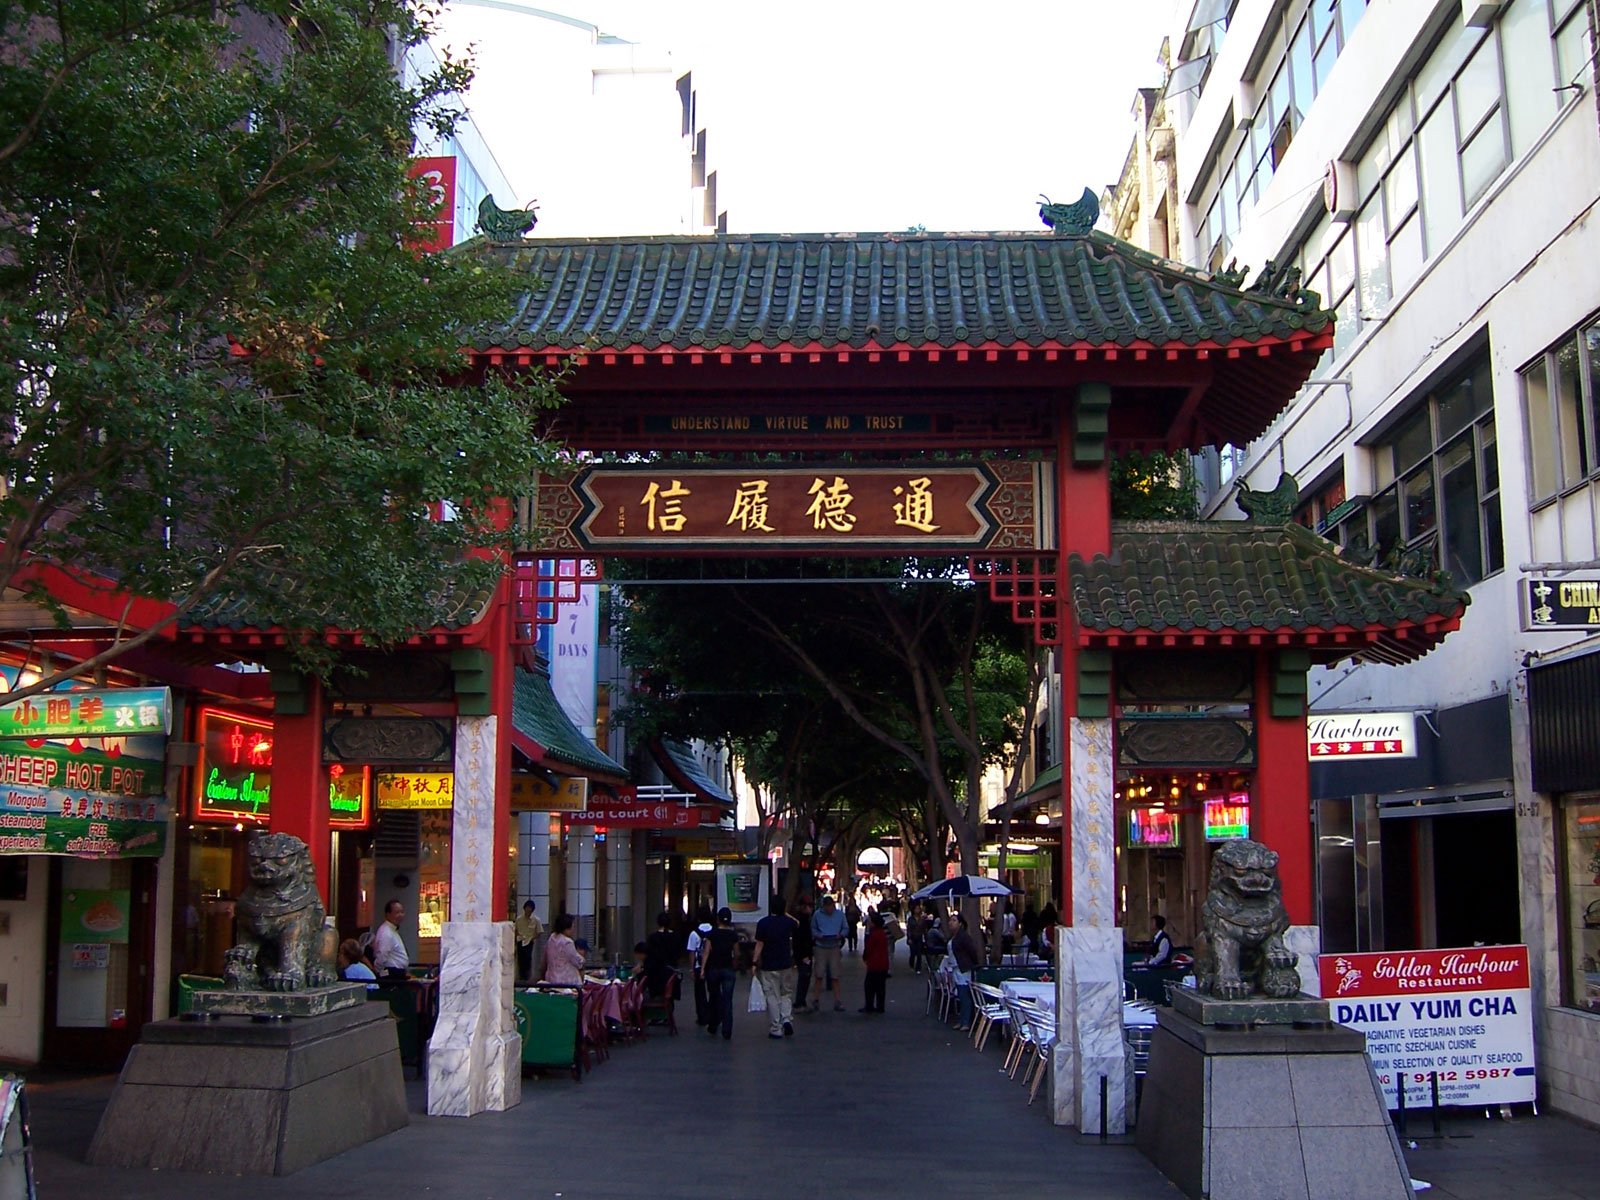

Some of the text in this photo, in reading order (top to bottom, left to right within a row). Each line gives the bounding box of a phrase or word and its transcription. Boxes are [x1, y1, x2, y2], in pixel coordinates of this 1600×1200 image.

[671, 415, 905, 430] UNDERSTAND VIRTUE AND TRUST
[569, 613, 579, 635] 7
[558, 644, 588, 657] DAYS
[13, 696, 104, 727] 小肥羊
[1307, 718, 1401, 740] Harbour
[66, 761, 105, 791] HOT
[111, 766, 145, 795] POT
[7, 791, 47, 810] Mongolia
[421, 798, 436, 807] Moon
[0, 813, 47, 829] steamboat
[571, 807, 649, 820] Food Court
[89, 823, 109, 837] FREE
[66, 837, 83, 851] soft
[1372, 952, 1520, 979] Golden Harbour
[1398, 975, 1483, 988] Restaurant
[1337, 997, 1518, 1025] DAILY YUM CHA
[1364, 1025, 1486, 1041] AGINATIVE VEGETARIAN DISHES
[1405, 1041, 1446, 1053] SZECHUAN
[1448, 1039, 1477, 1050] CUISINE
[1393, 1058, 1435, 1069] SELECTION
[1437, 1056, 1447, 1066] OF
[1451, 1055, 1487, 1066] QUALITY
[1487, 1053, 1523, 1064] SEAFOOD
[1465, 1068, 1512, 1080] 5987
